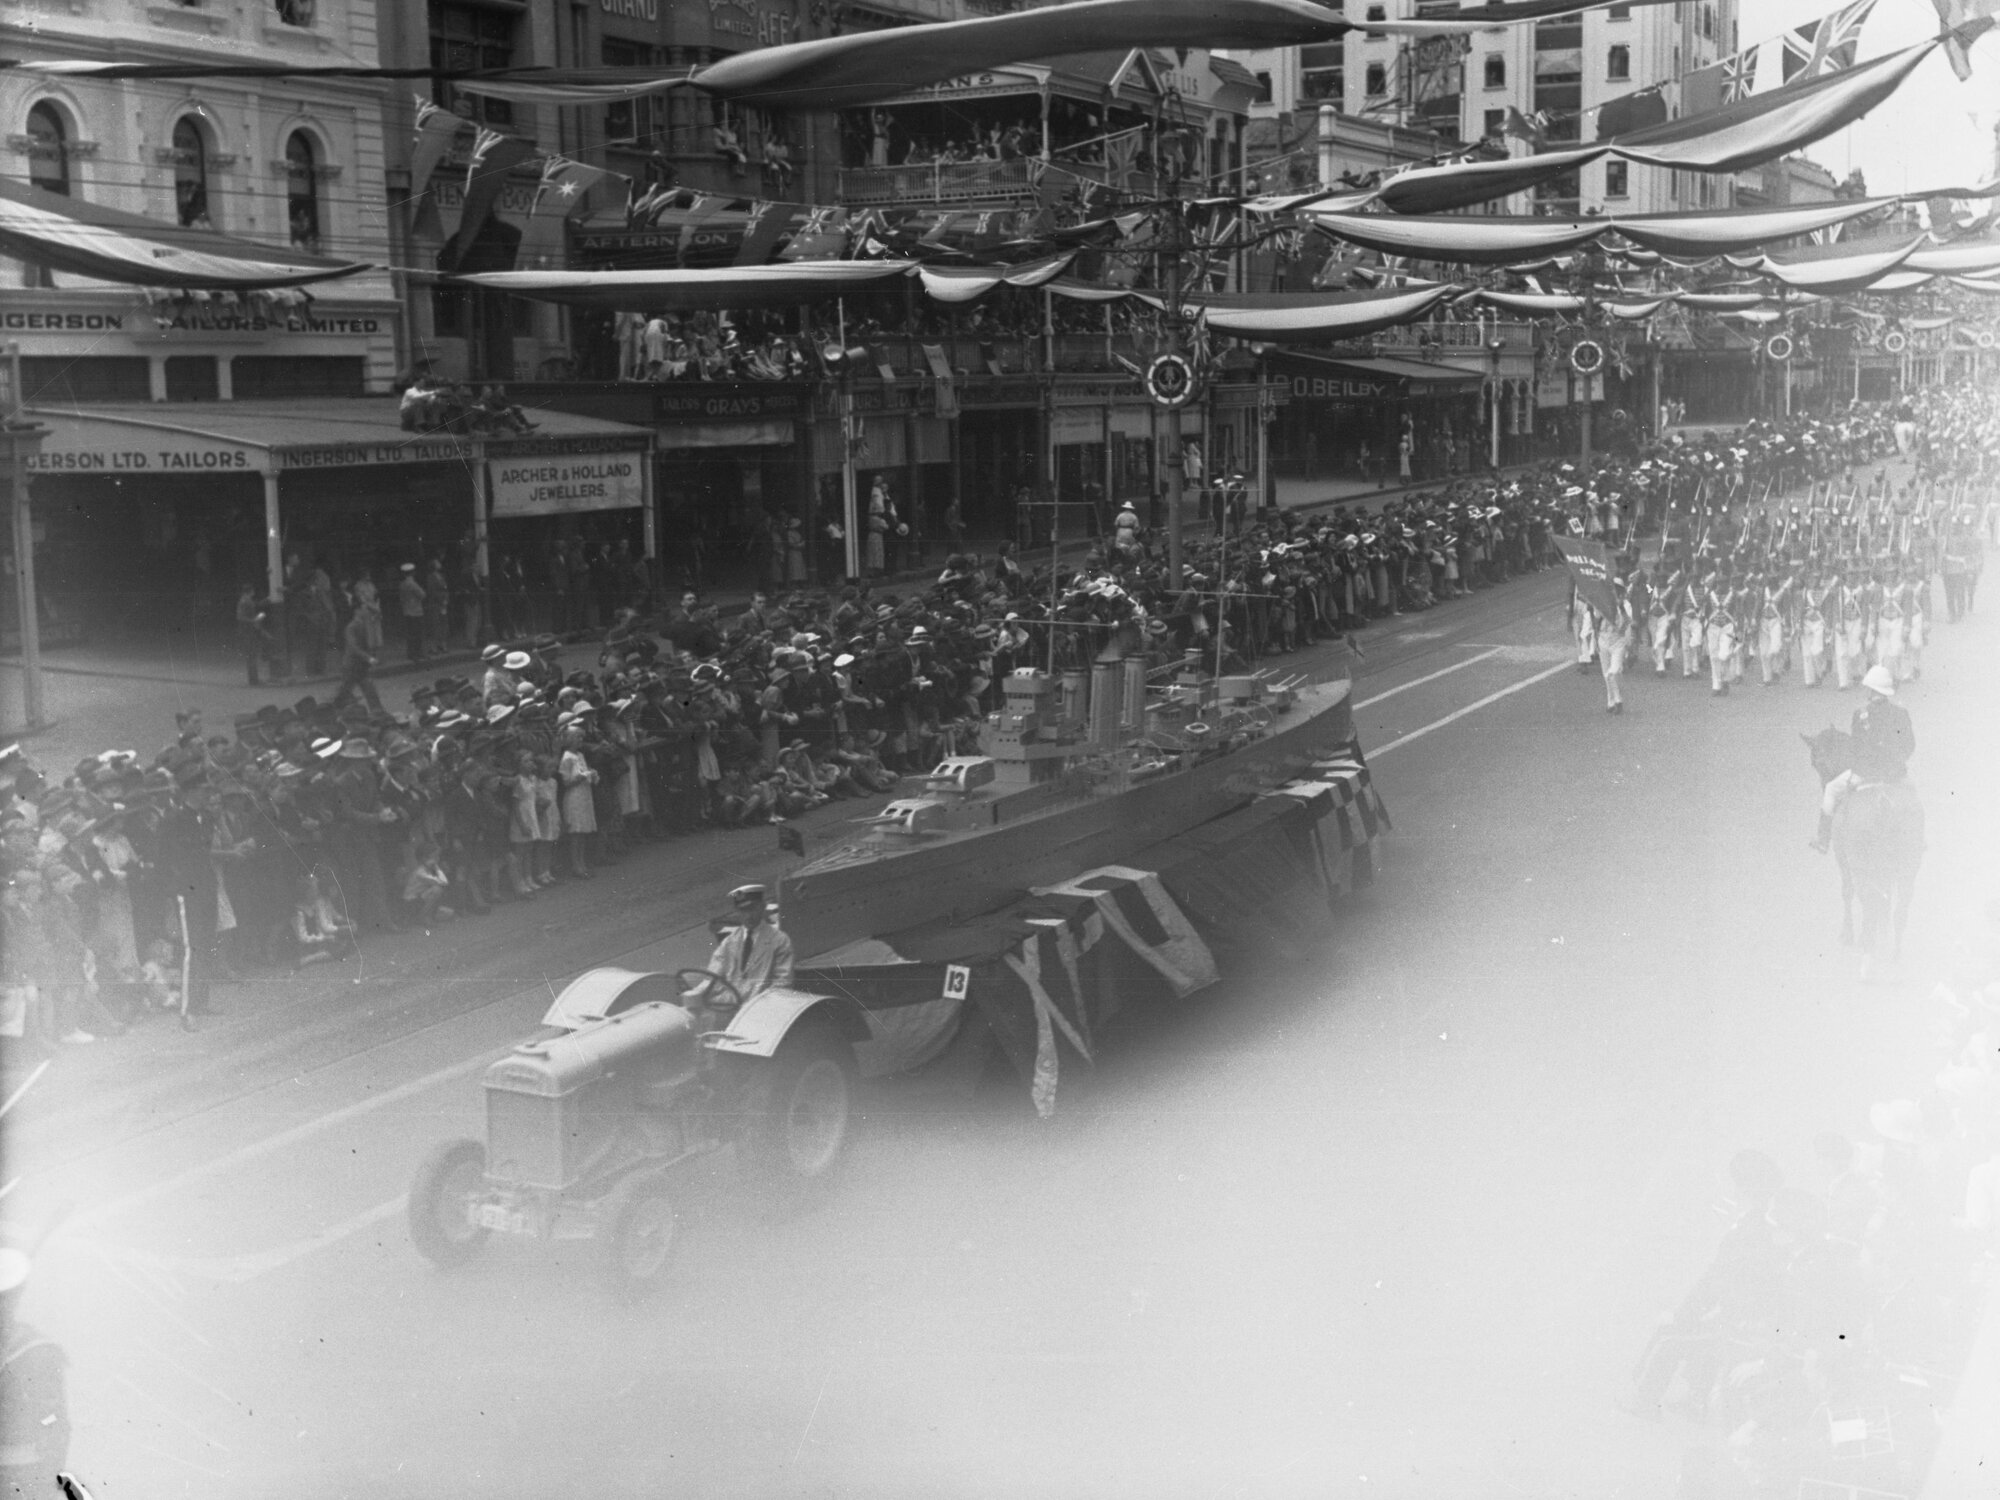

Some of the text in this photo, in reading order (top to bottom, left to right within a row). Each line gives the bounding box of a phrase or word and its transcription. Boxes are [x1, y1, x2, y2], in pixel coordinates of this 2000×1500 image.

[583, 233, 727, 249] AFTERNON
[0, 313, 122, 330] GERSON
[156, 314, 266, 331] AILORS
[705, 397, 760, 415] GRAYS
[26, 451, 251, 469] GERSON LTD. TAILORS.
[281, 447, 366, 467] INGERSON
[501, 463, 632, 484] ARCHER & HOLLAND
[529, 484, 608, 502] JEWELLERS.
[947, 970, 966, 993] 13
